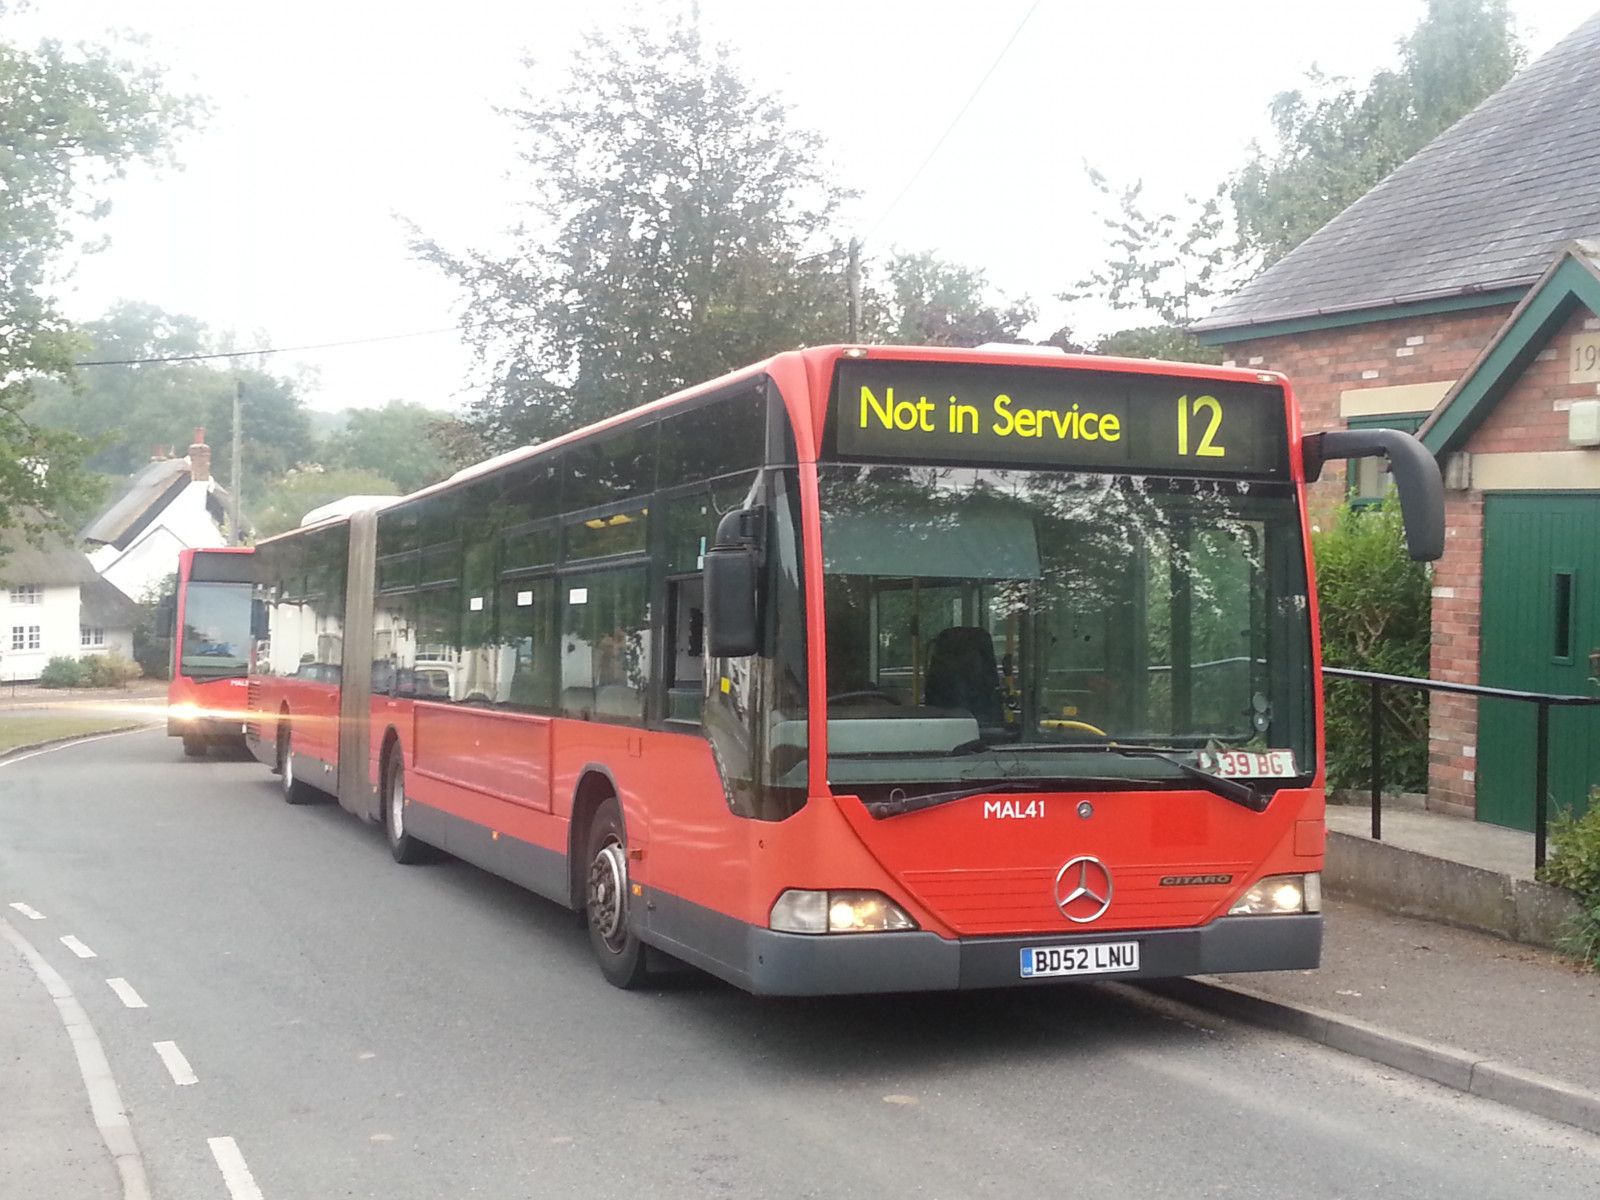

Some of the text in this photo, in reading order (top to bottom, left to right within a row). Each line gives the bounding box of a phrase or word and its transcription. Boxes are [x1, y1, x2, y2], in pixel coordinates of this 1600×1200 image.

[1574, 344, 1600, 372] 19
[860, 386, 1121, 442] Not in Service
[1177, 393, 1226, 457] 12
[1211, 753, 1284, 775] 39 BG
[984, 800, 1045, 819] MAL41
[1160, 874, 1231, 885] CITARO
[1035, 944, 1134, 973] BD52 LNU
